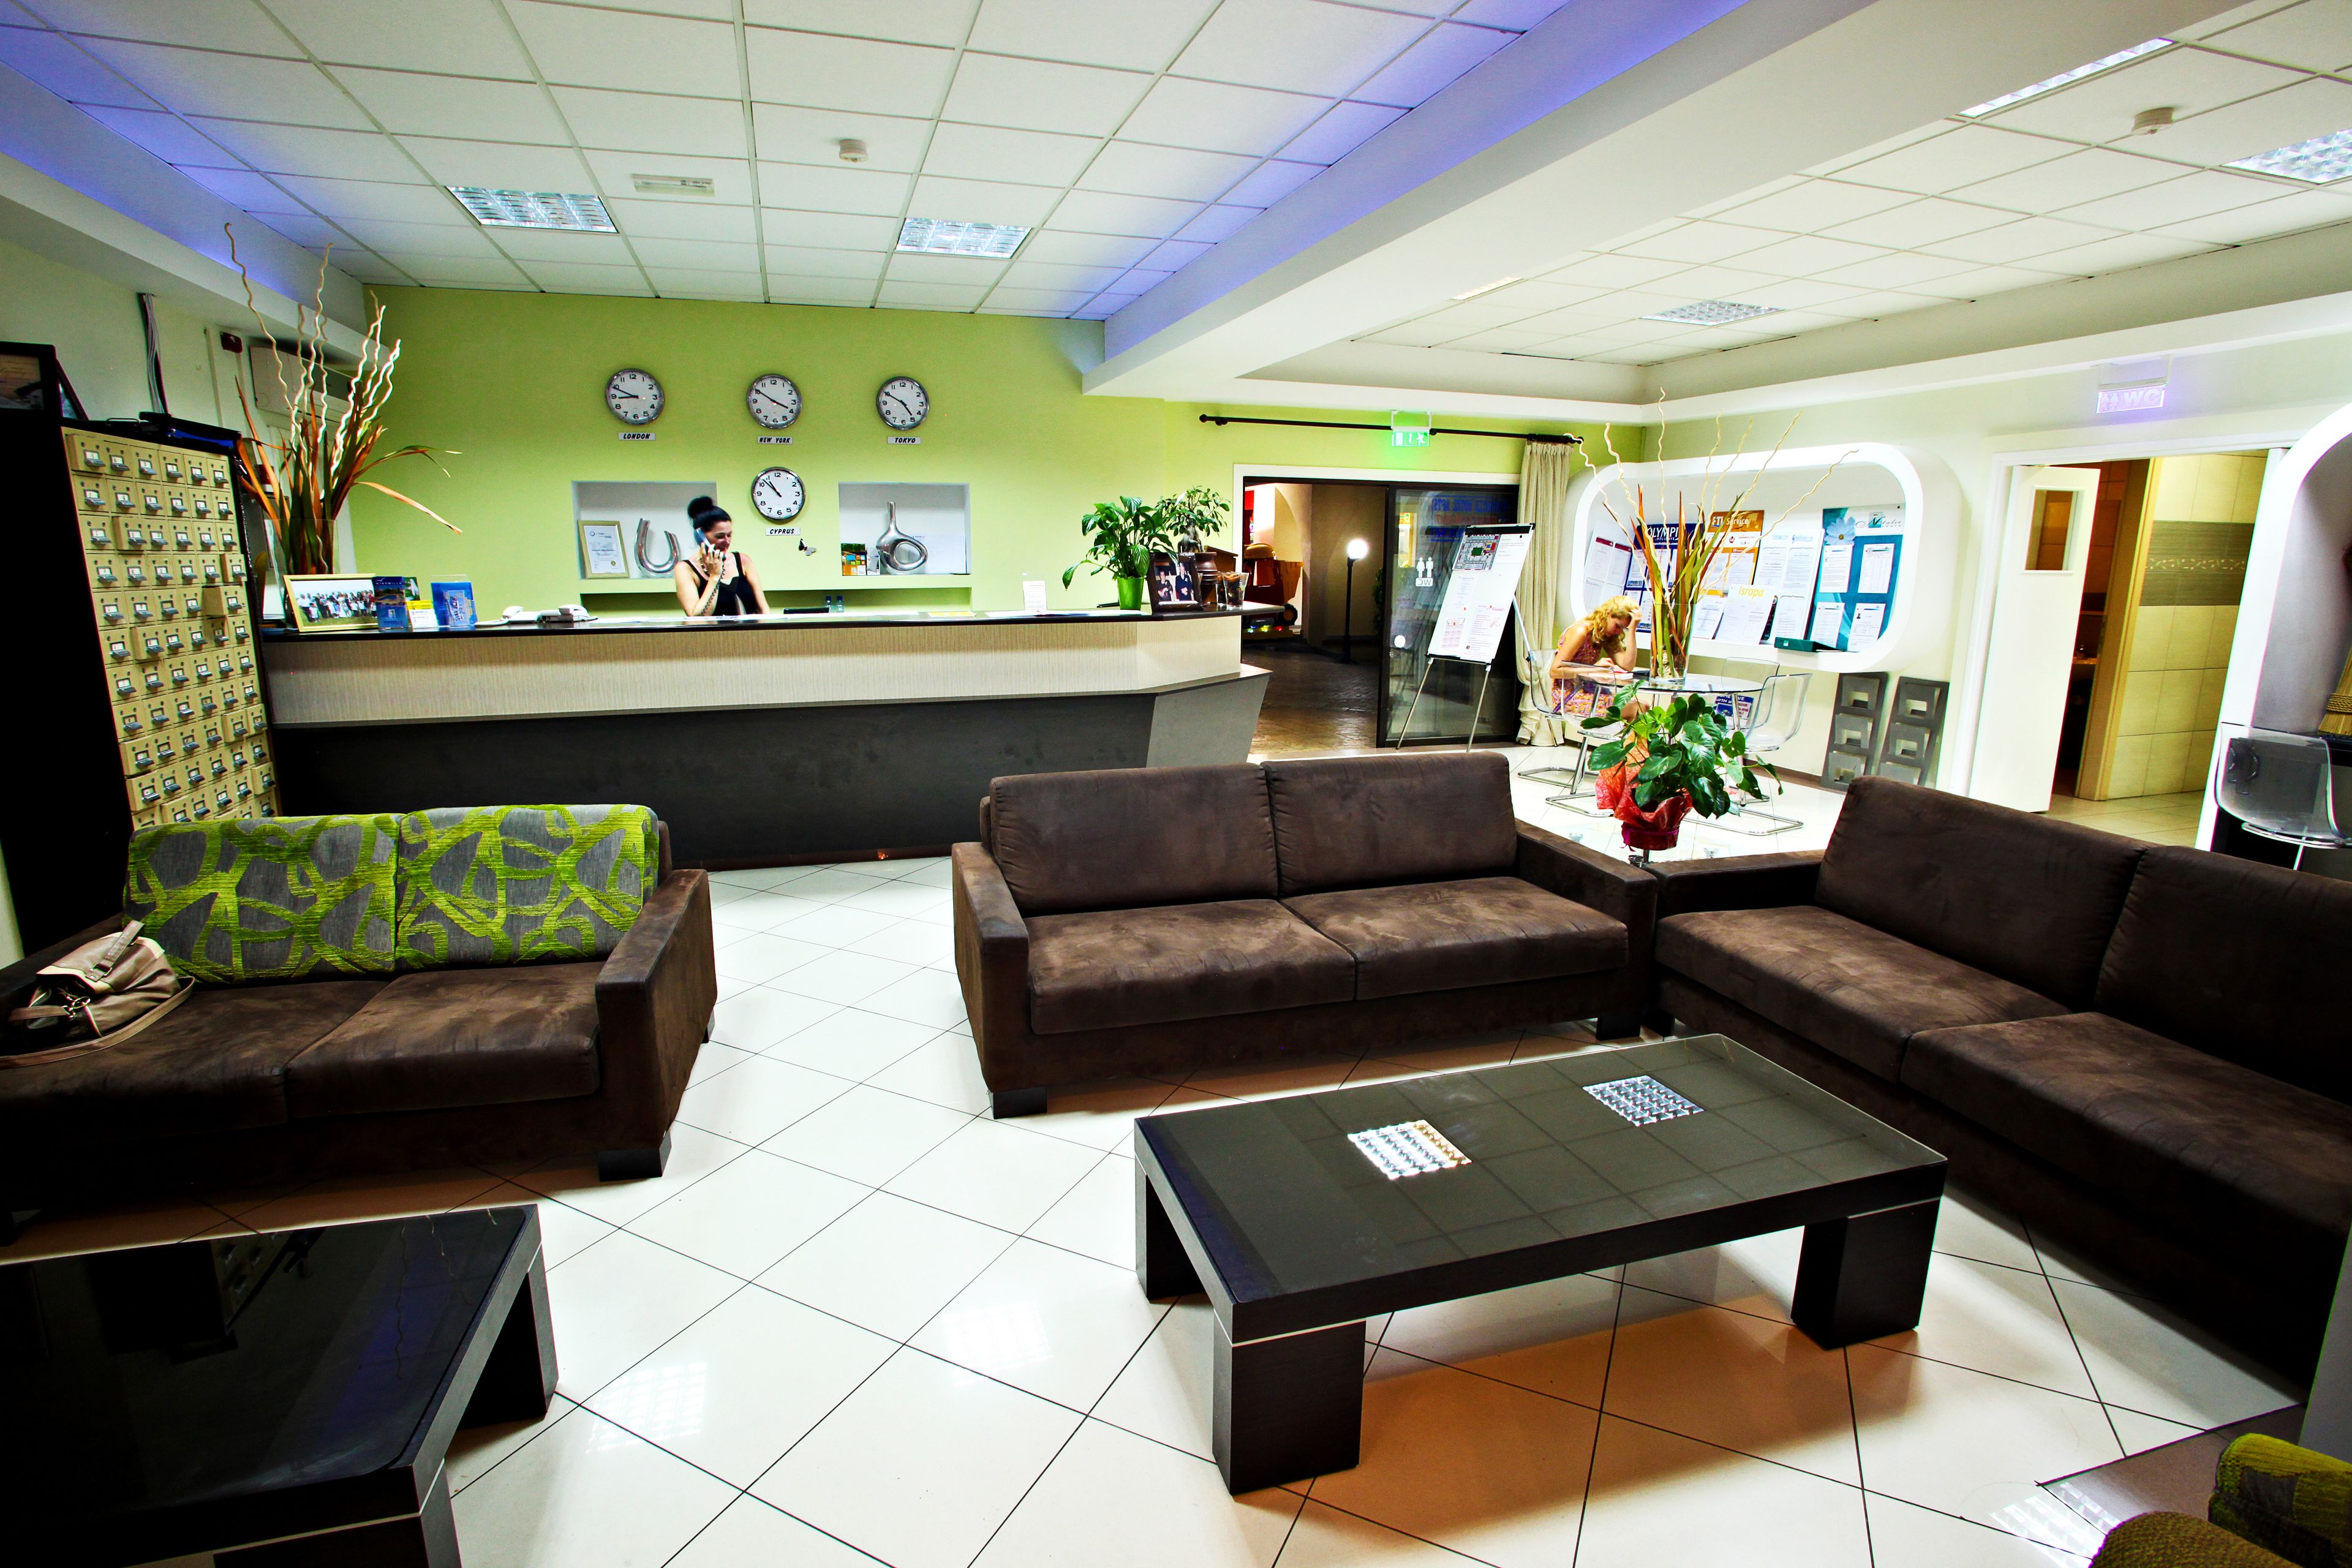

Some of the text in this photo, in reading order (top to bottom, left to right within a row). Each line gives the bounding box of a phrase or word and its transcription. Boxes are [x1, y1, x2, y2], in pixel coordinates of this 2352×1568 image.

[2124, 388, 2161, 407] WC
[1647, 526, 1679, 537] OLYMPI
[1738, 586, 1765, 598] Isropa
